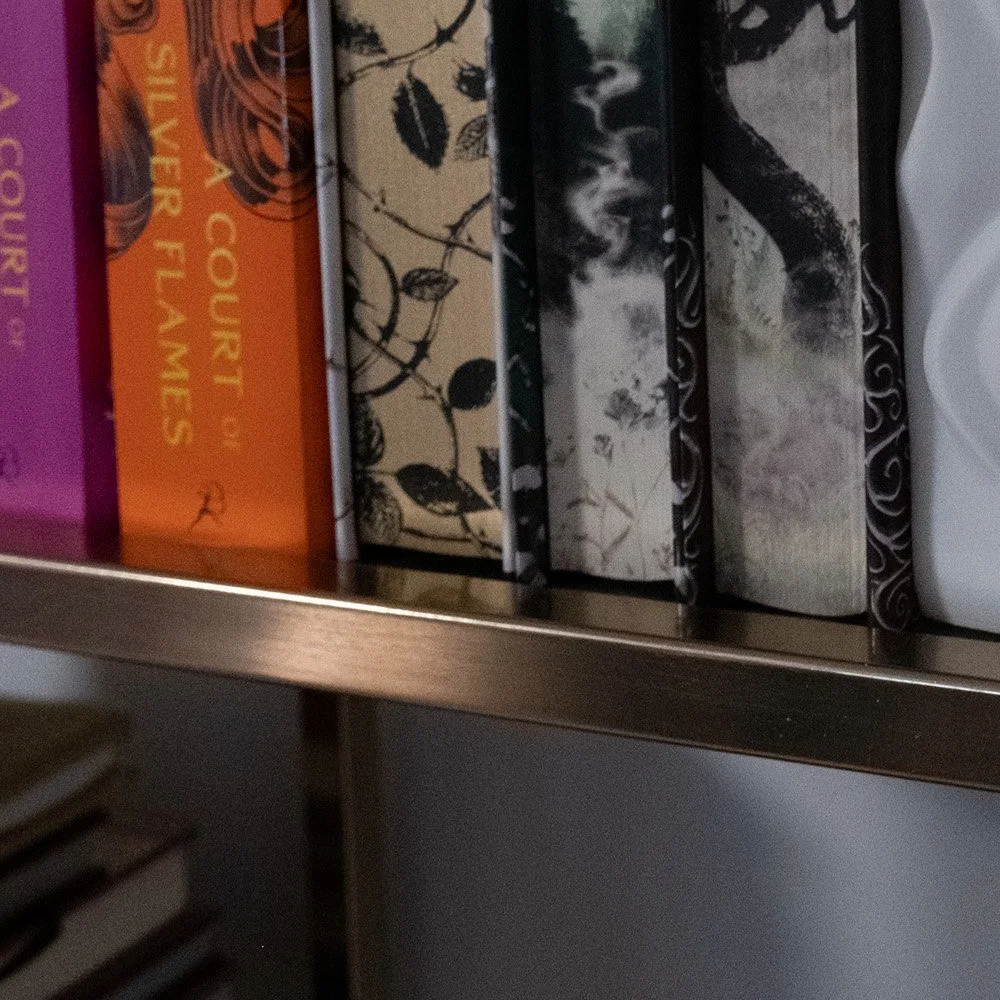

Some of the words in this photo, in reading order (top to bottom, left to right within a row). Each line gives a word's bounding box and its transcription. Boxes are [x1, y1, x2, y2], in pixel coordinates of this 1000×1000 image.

[145, 43, 184, 217] SILVER
[203, 154, 233, 189] A
[0, 136, 30, 309] COURT
[205, 212, 244, 396] COURT
[154, 239, 195, 447] FLAMES
